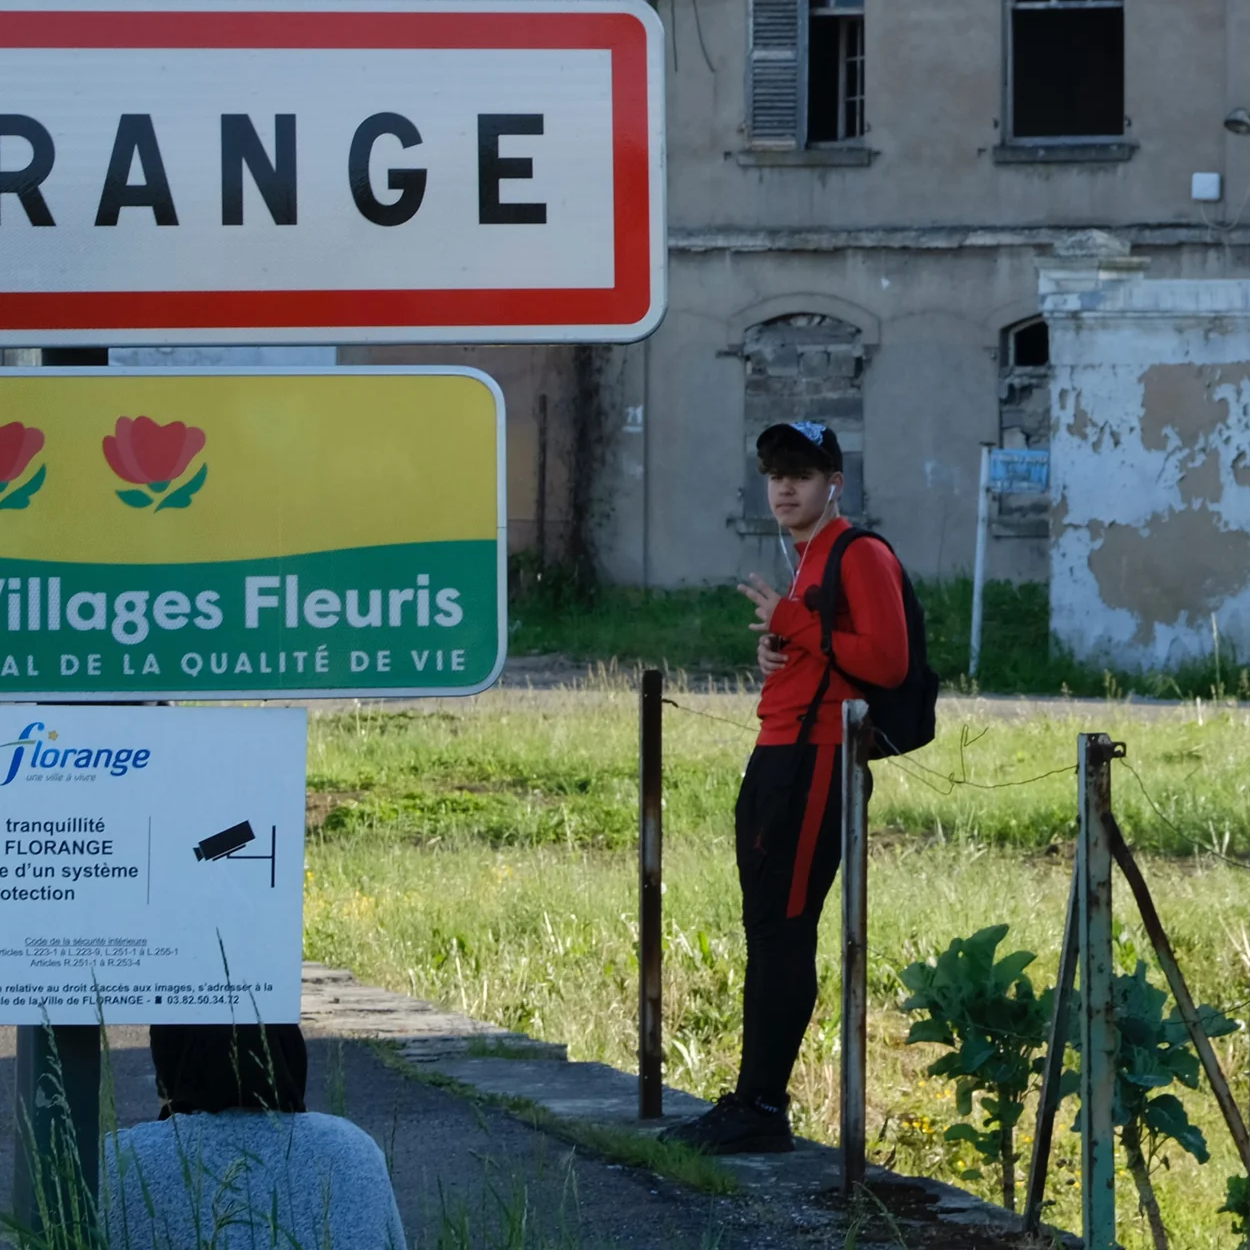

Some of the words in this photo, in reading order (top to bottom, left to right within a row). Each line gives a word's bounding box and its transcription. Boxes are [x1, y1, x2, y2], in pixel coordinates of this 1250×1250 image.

[0, 111, 548, 227] RANGE
[0, 576, 224, 645] illages
[244, 573, 464, 629] Fleuris
[0, 654, 39, 677] AL
[60, 654, 102, 676] DE
[123, 653, 161, 676] LA
[180, 645, 330, 678] QUALITÉ
[350, 651, 392, 673] DE
[411, 649, 466, 672] VIE
[0, 721, 151, 786] florange
[5, 817, 105, 836] tranquillité
[5, 840, 114, 856] FLORANGE
[15, 862, 55, 878] d'un
[61, 862, 139, 881] système
[0, 885, 76, 901] otection
[25, 936, 48, 946] Code
[49, 936, 61, 946] de
[30, 957, 62, 968] Articles
[5, 983, 44, 993] relative
[46, 985, 60, 993] au
[62, 983, 88, 993] droit
[132, 985, 152, 993] aux
[154, 983, 195, 995] images,
[254, 982, 262, 993] à
[263, 982, 273, 993] la
[12, 996, 26, 1006] de
[40, 995, 64, 1006] Ville
[66, 996, 80, 1006] de
